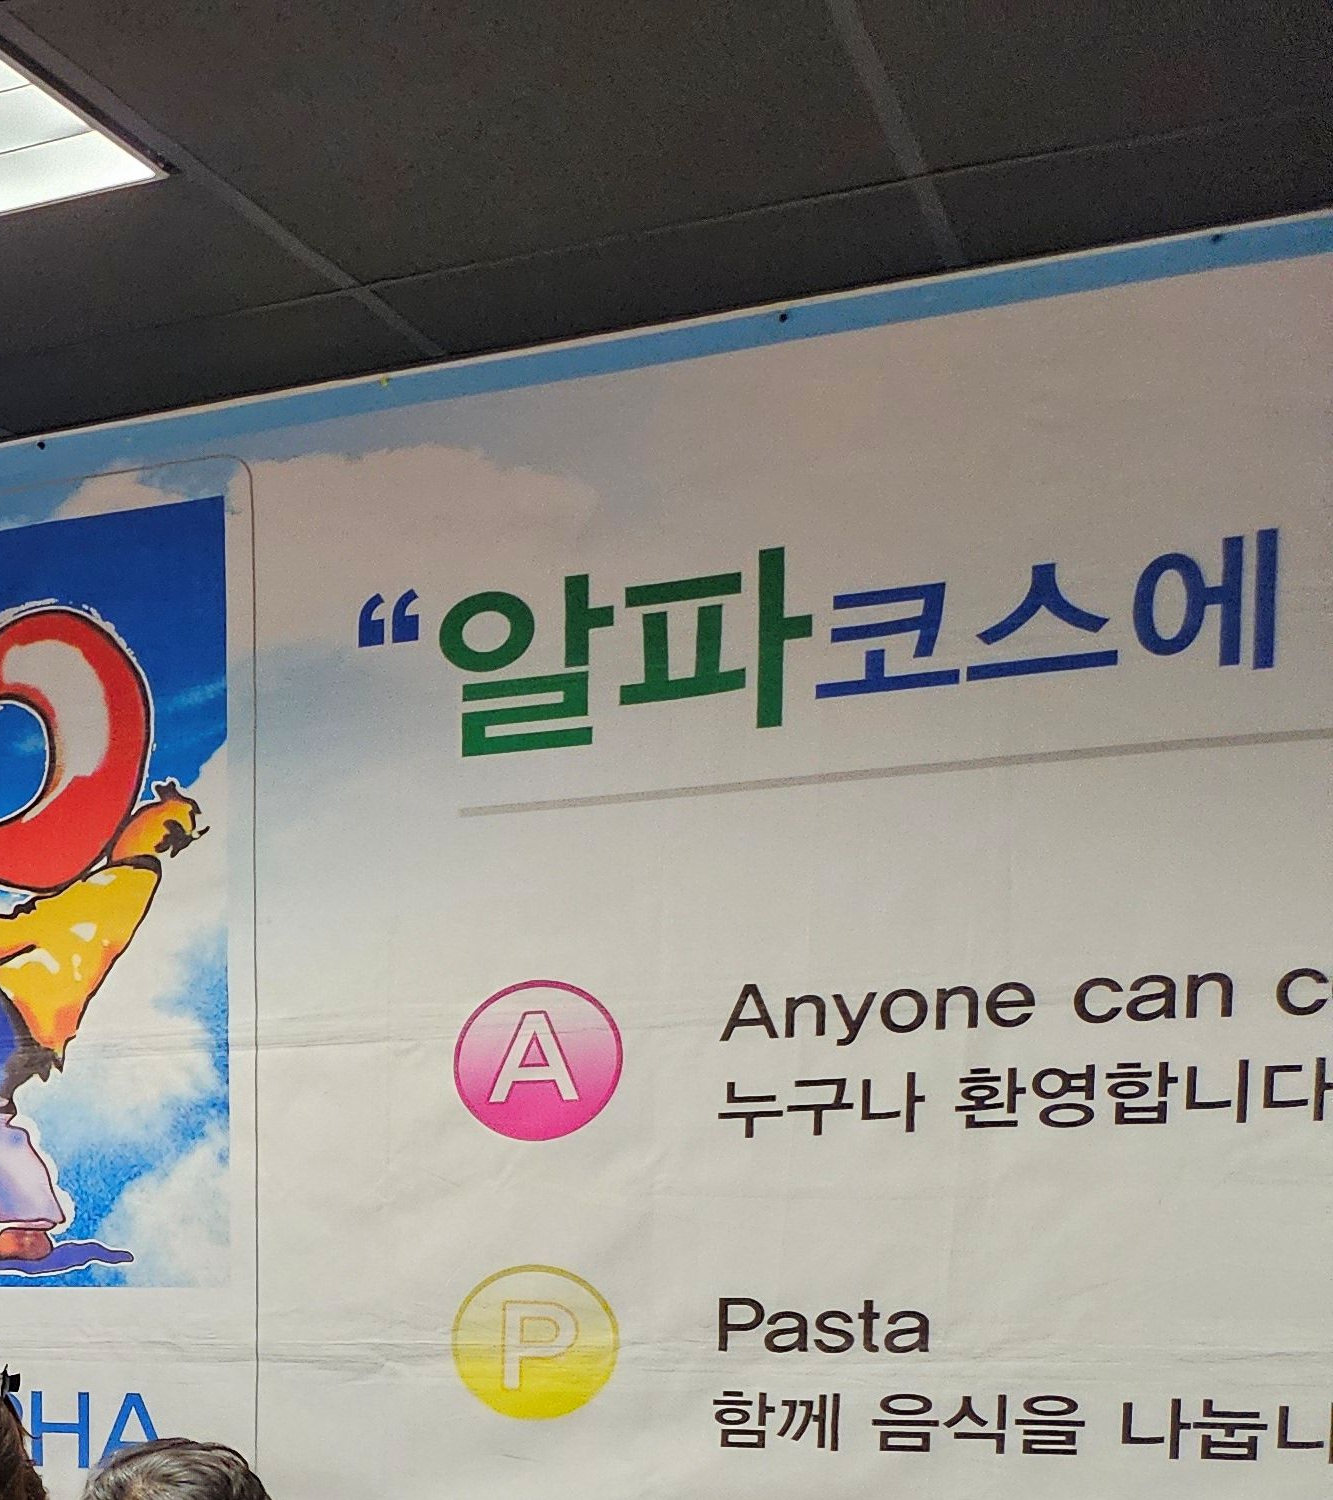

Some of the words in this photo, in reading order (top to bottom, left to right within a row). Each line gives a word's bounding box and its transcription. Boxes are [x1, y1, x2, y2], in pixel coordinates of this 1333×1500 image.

[719, 979, 1036, 1047] Anyone
[1073, 968, 1234, 1023] can
[485, 1010, 582, 1104] A
[718, 1071, 927, 1138] 누구나
[955, 1057, 1333, 1131] 환영합니다
[500, 1300, 580, 1392] P
[718, 1297, 931, 1354] Pasta
[713, 1390, 840, 1452] 함께
[871, 1394, 1086, 1457] 음식을
